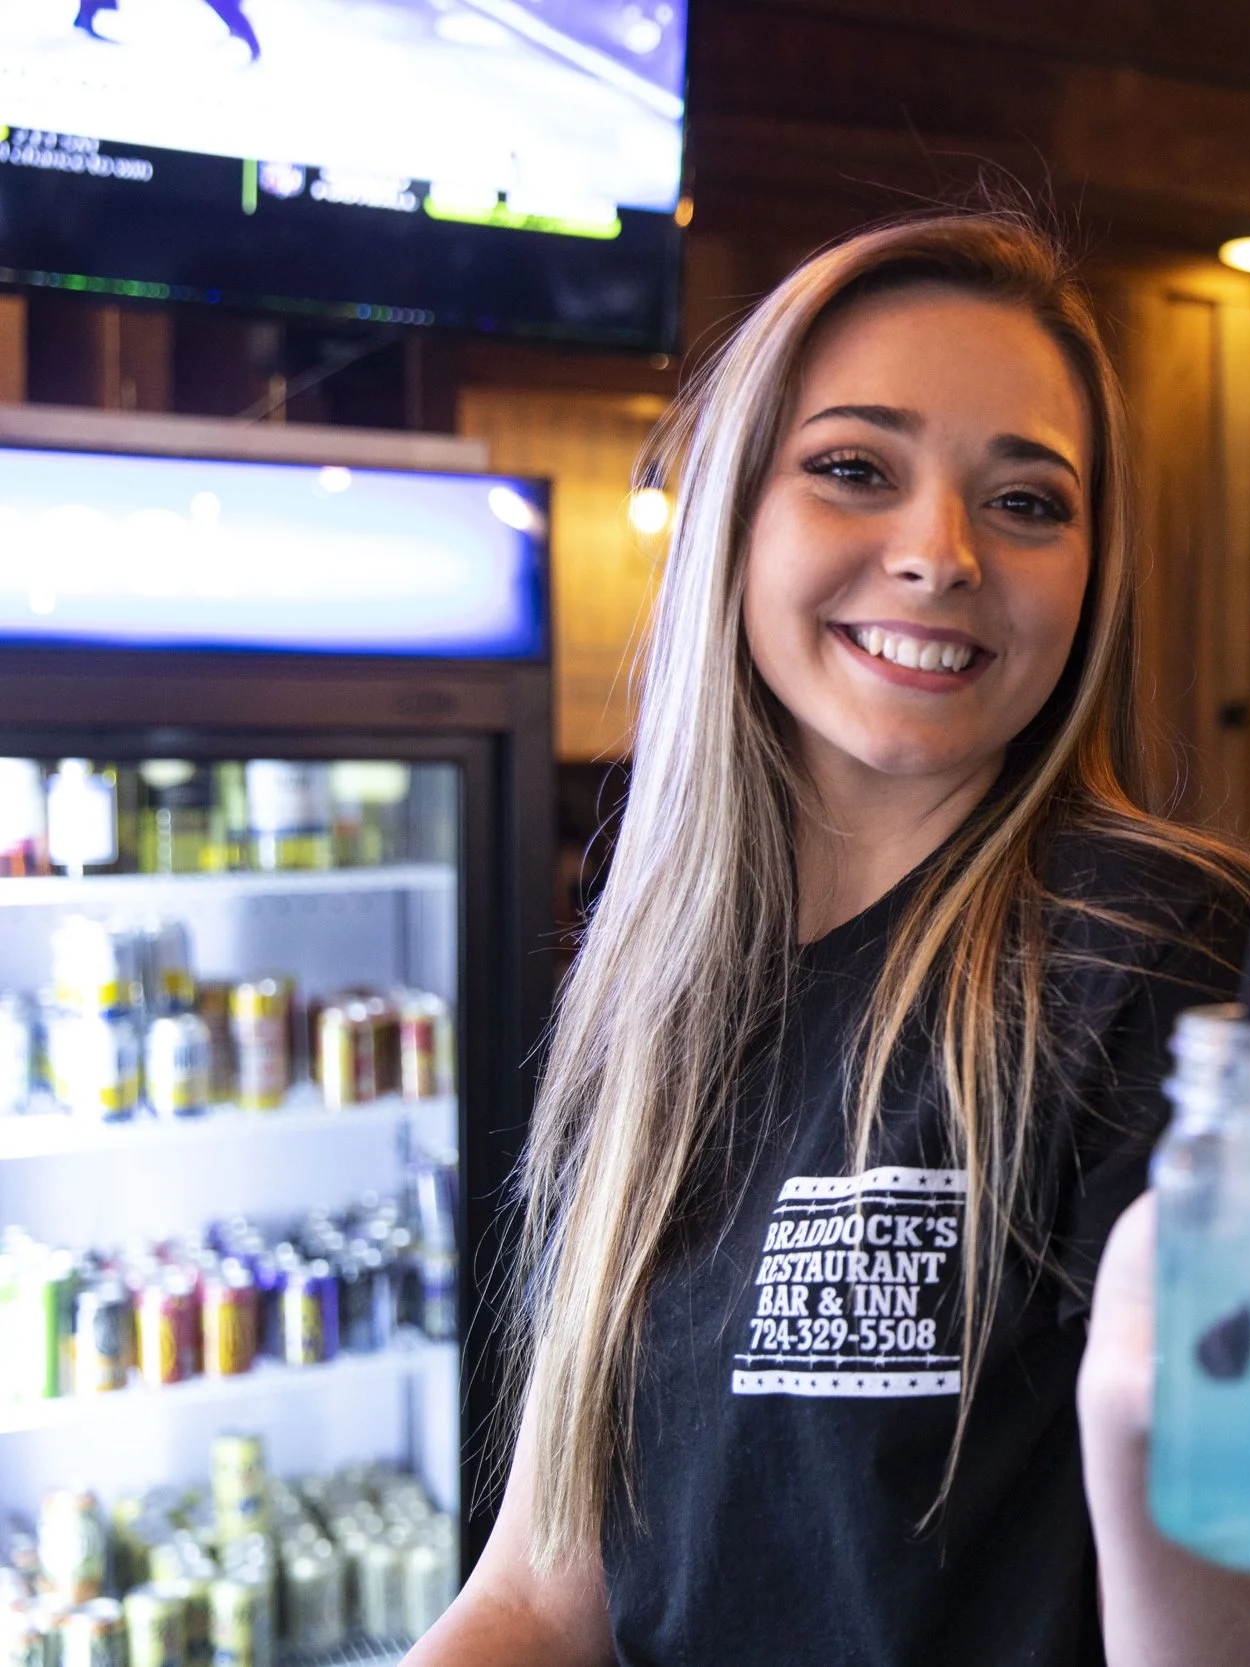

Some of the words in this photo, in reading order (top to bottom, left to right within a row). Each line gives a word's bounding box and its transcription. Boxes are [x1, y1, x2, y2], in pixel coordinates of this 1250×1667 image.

[763, 1214, 958, 1252] BRADDOCK'S
[755, 1250, 946, 1285] RESTAURANT
[757, 1285, 809, 1317] BAR
[818, 1287, 843, 1317] &
[853, 1285, 920, 1317] INN
[750, 1318, 936, 1351] 724-329-5508
